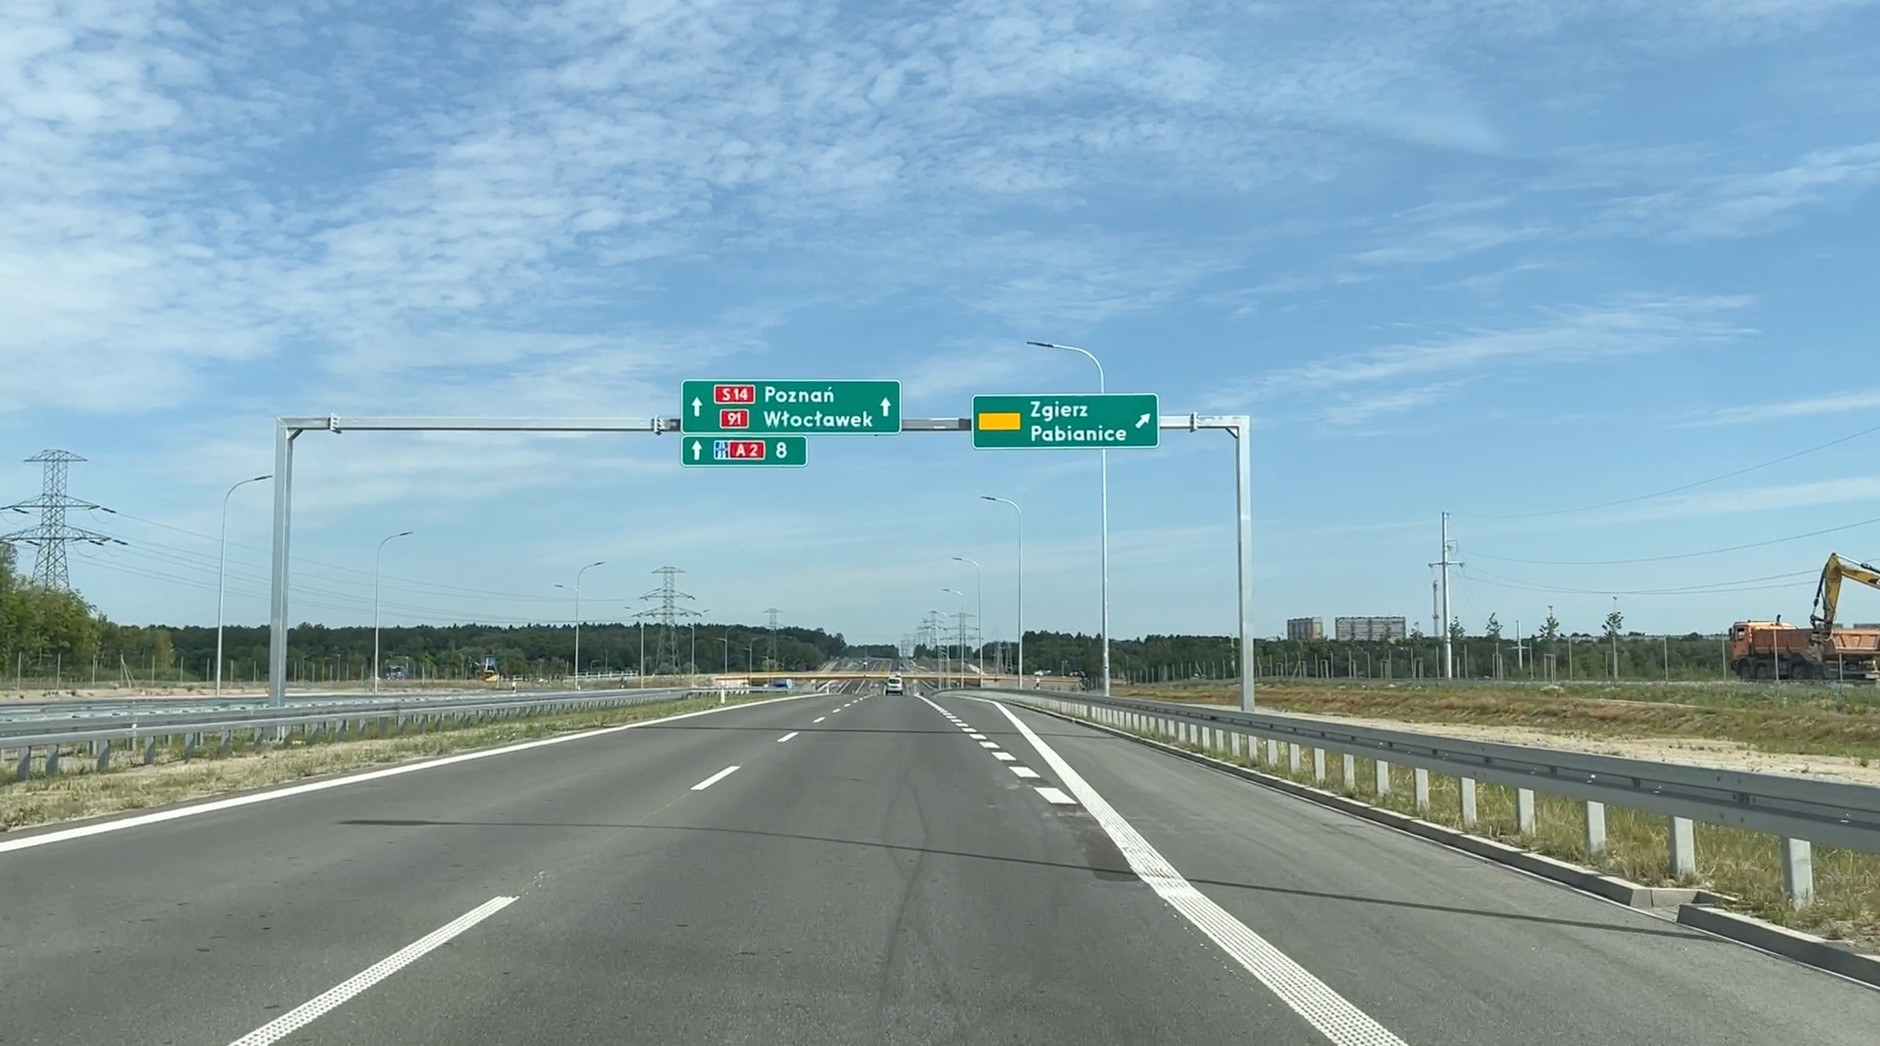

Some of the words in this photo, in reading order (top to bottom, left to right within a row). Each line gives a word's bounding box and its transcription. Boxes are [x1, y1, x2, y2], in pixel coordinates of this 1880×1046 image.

[765, 386, 834, 403] Poznań
[727, 412, 741, 426] 91
[763, 410, 873, 428] Włocławek
[1030, 401, 1088, 422] Zgierz
[1031, 425, 1127, 442] Pabianice
[775, 441, 787, 459] 8
